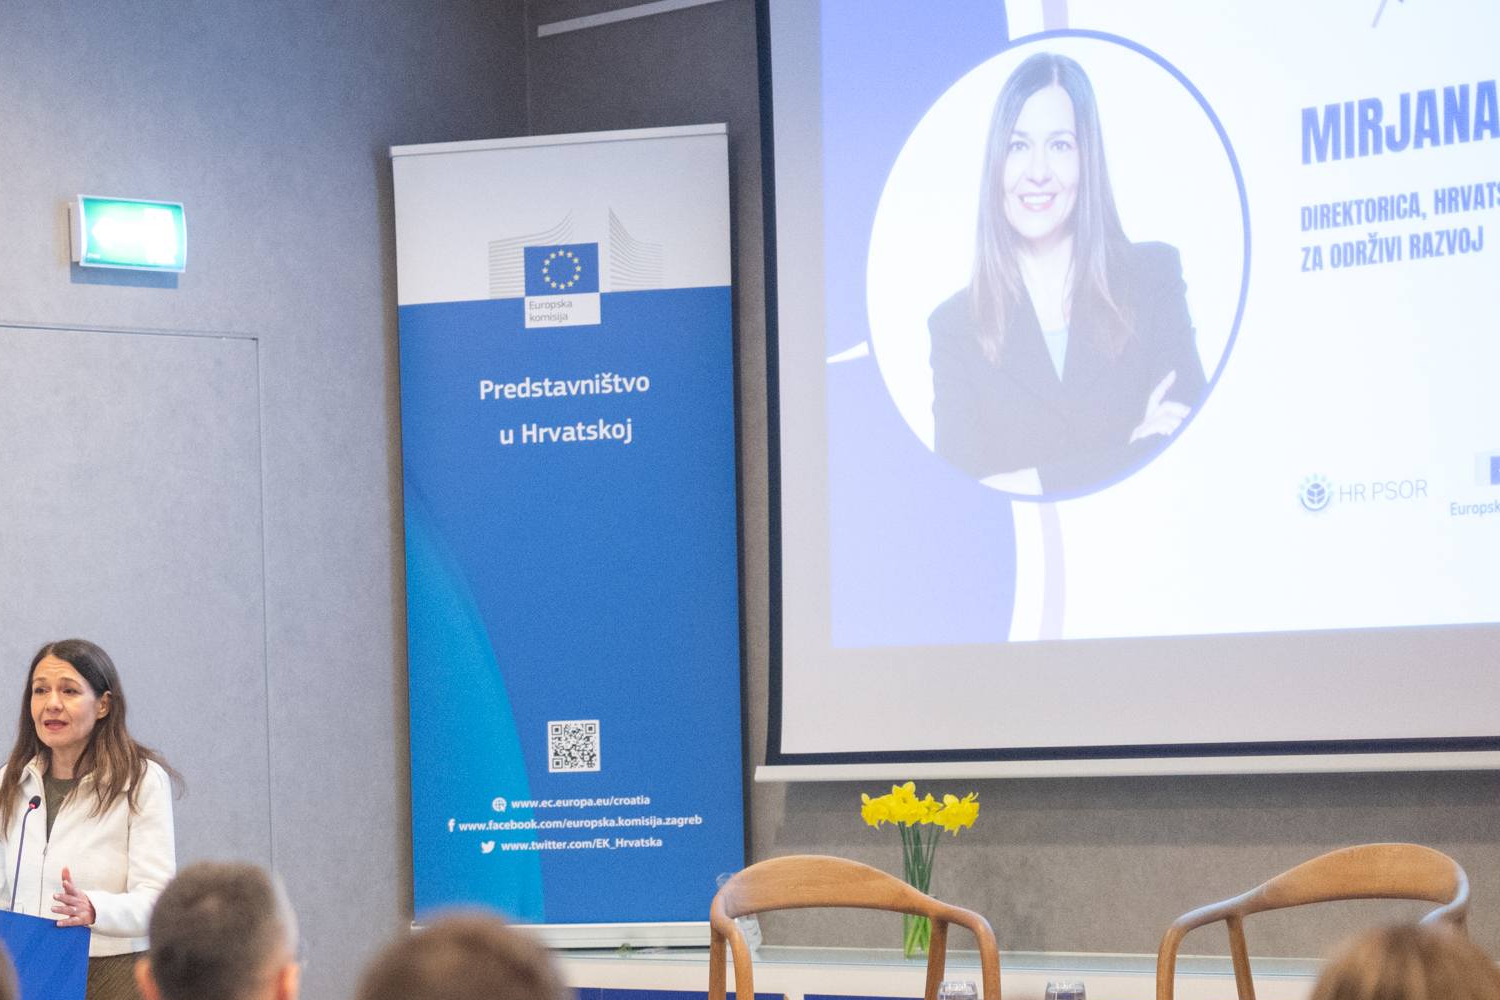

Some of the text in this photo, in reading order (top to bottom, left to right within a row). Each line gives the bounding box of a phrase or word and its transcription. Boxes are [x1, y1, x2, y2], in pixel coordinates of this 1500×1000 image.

[1301, 79, 1500, 165] MIRJANA
[1300, 191, 1428, 232] DIREKTORICA,
[1301, 225, 1484, 273] ZA ODRŽIVI RAZVOJ
[529, 300, 573, 311] Europska
[529, 311, 569, 323] komisija
[479, 372, 651, 401] Predstavništvo
[499, 418, 634, 446] u Hrvatskoj
[1339, 478, 1428, 503] HR PSOR
[511, 795, 651, 809] www.ec.europa.eu/croatia
[458, 814, 703, 832] www.facebook.com/europska.komisija.zagreb
[500, 837, 663, 852] www.twitter.com/EK_Hrvatska
